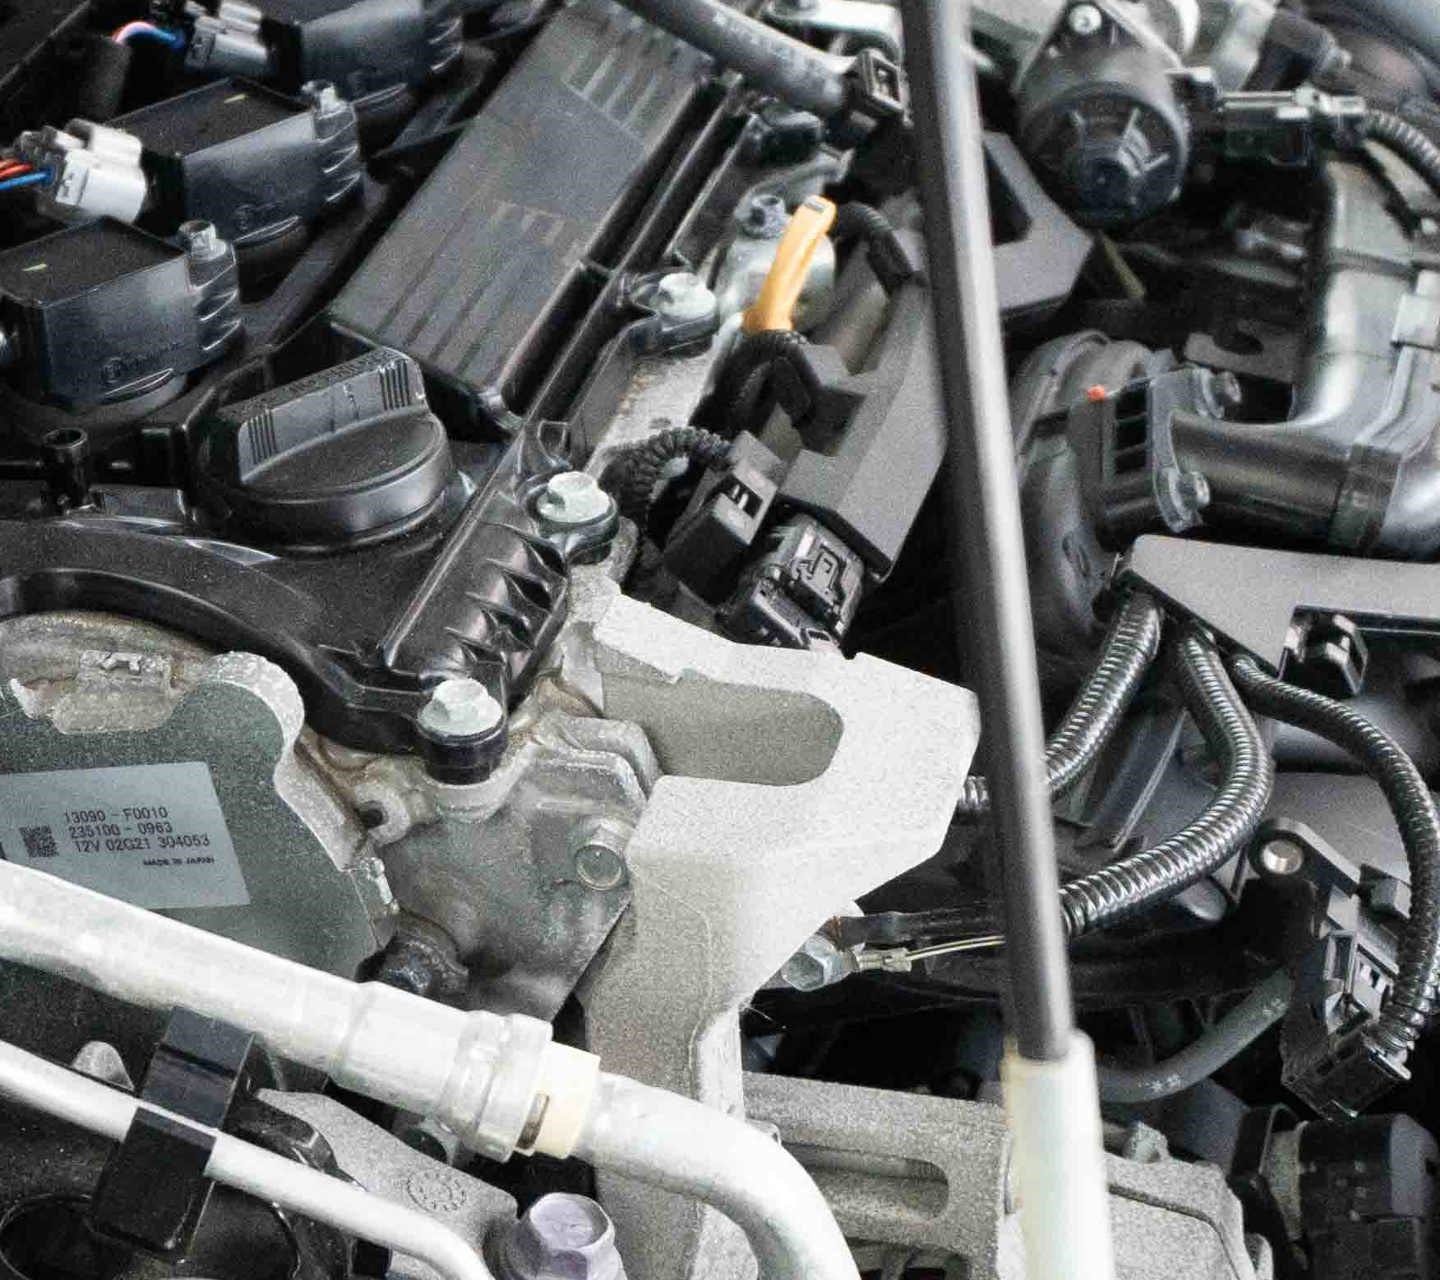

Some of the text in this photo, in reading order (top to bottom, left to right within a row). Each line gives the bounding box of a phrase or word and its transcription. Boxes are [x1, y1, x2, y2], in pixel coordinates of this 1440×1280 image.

[65, 809, 106, 824] 13090
[69, 825, 120, 840] 235100
[75, 839, 100, 854] 12V
